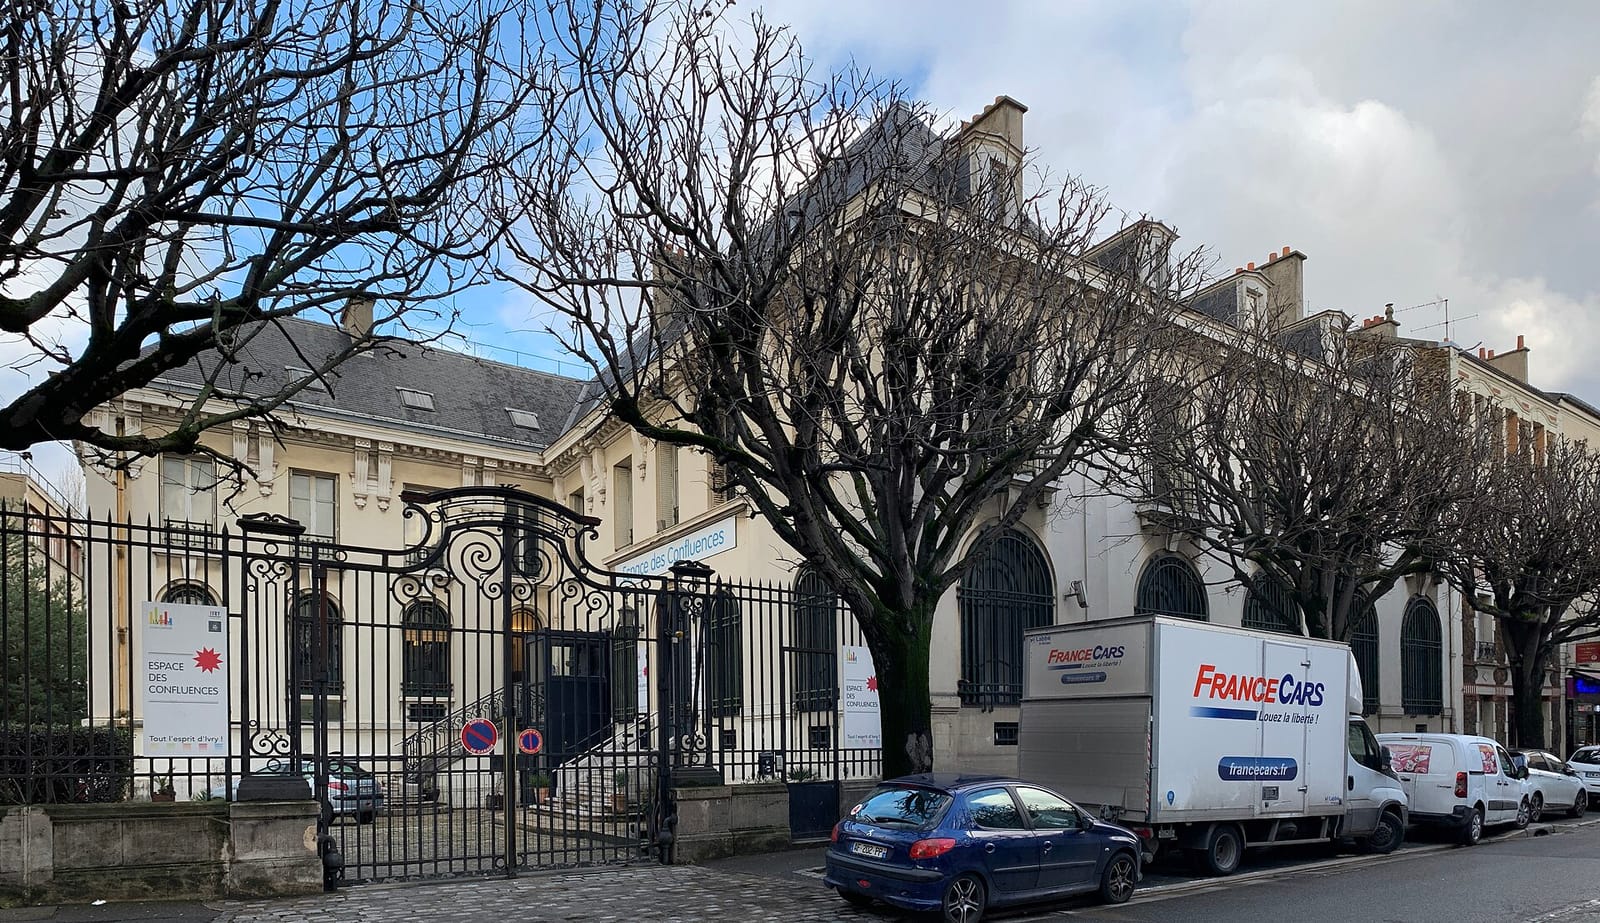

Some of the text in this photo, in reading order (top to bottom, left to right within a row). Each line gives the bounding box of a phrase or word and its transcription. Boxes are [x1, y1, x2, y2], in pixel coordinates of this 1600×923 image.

[622, 530, 725, 578] pace des Confluences
[148, 661, 184, 672] ESPACE
[148, 673, 168, 683] DES
[148, 685, 219, 696] CONFLUENCES
[1259, 711, 1282, 723] Louez
[1283, 711, 1290, 723] la
[1291, 711, 1315, 725] liberté
[149, 735, 166, 743] Tout
[169, 735, 195, 745] l'esprit
[198, 735, 218, 745] d'Ivry
[1229, 762, 1288, 776] francecars.fr
